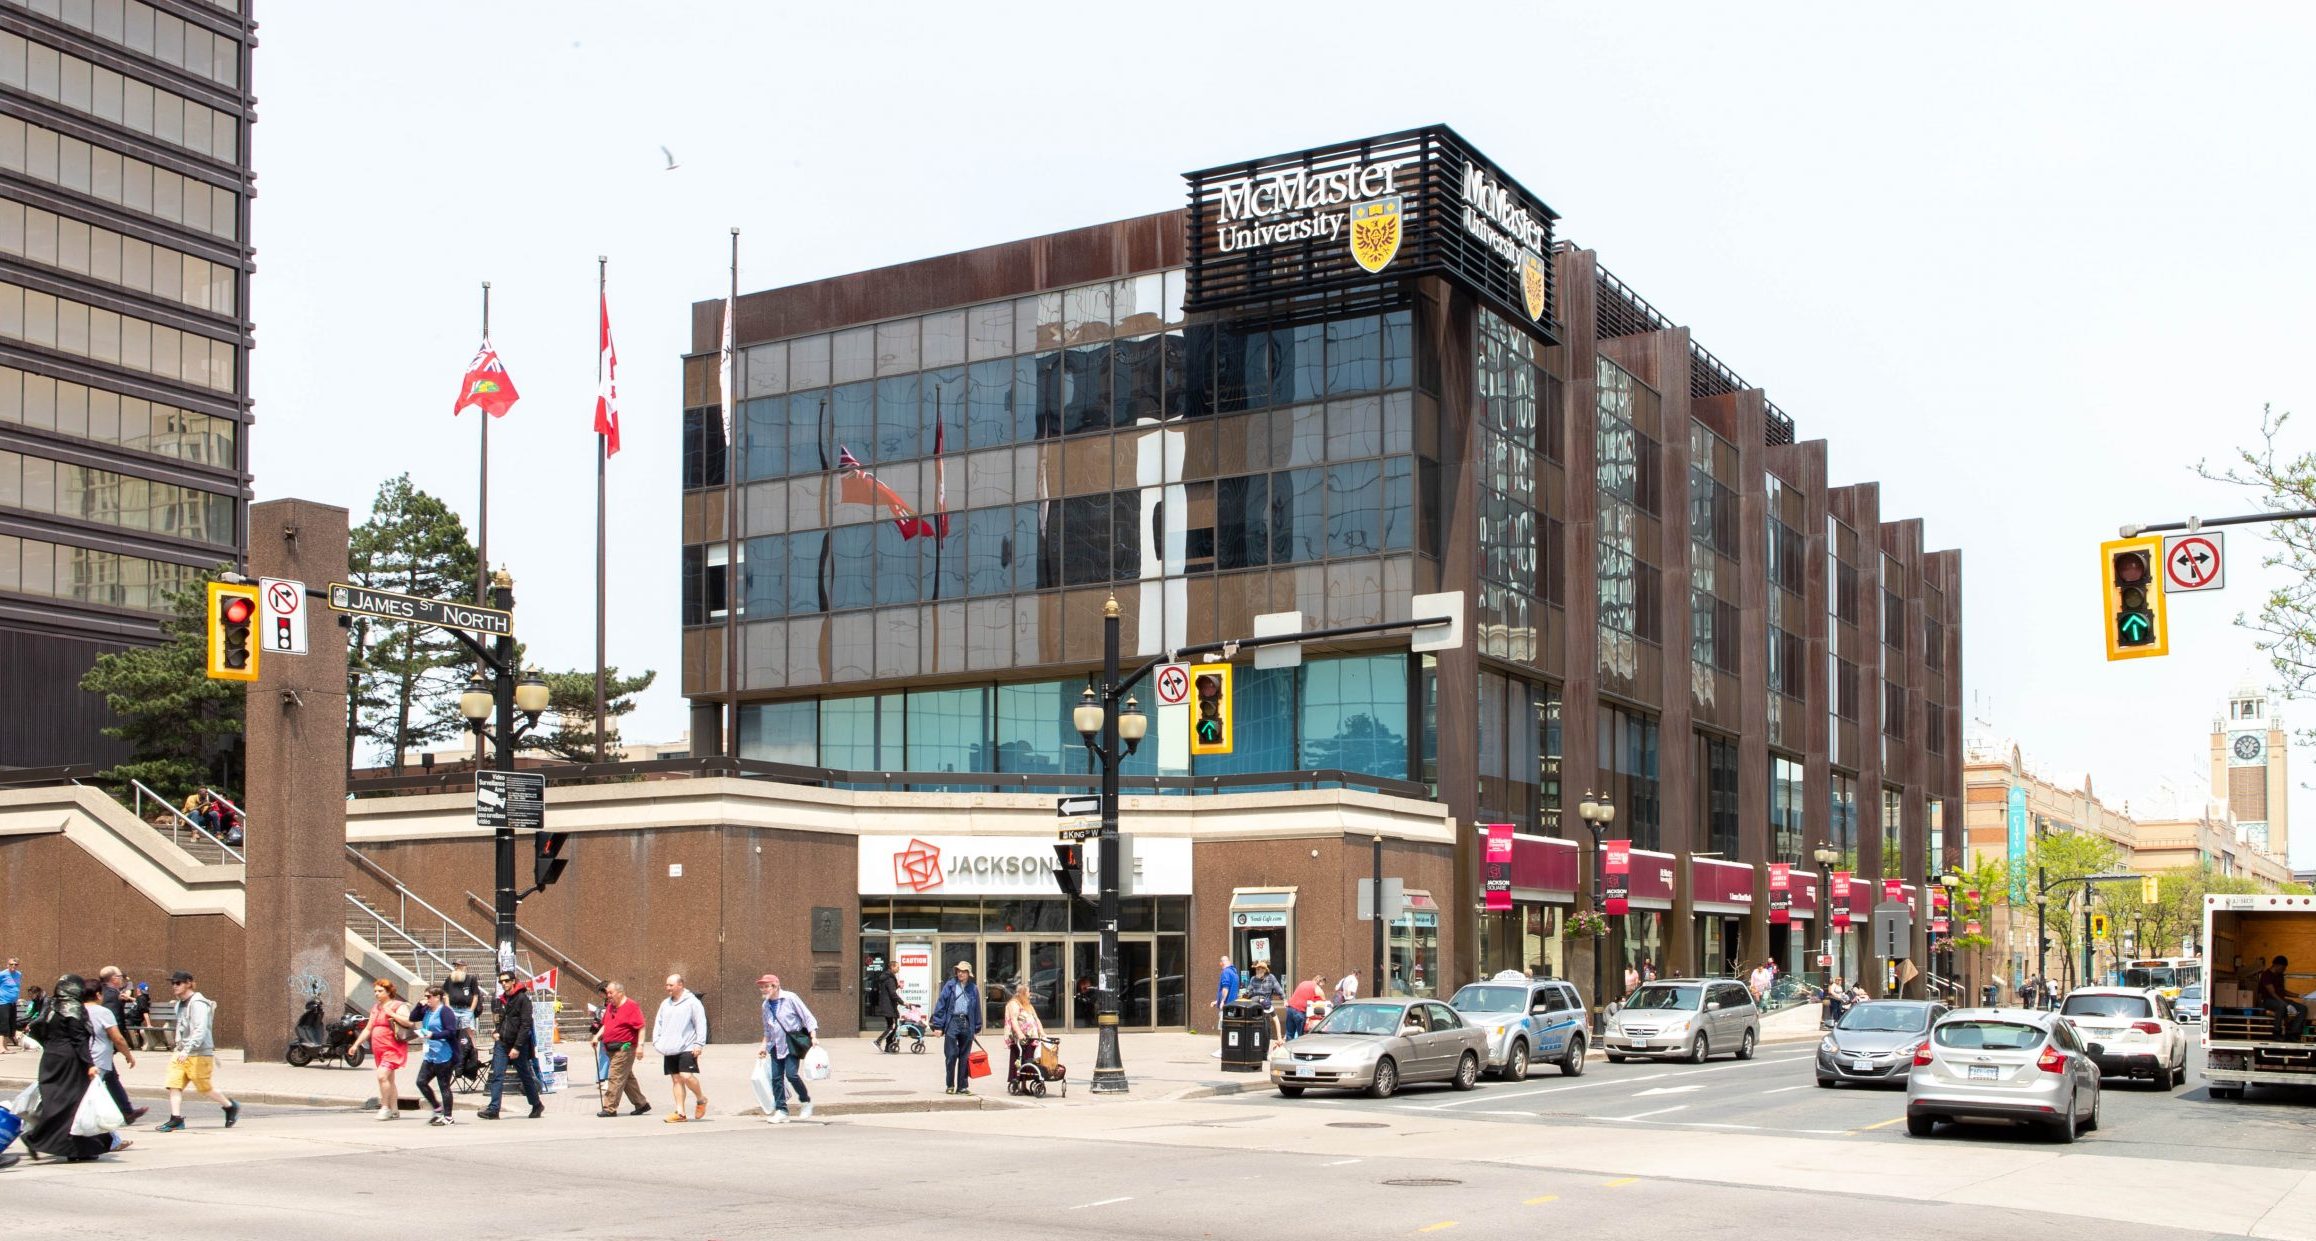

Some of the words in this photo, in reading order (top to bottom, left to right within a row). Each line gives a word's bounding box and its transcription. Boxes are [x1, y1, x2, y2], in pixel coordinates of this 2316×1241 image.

[1217, 163, 1403, 224] McMaster
[1461, 160, 1544, 255] McMaster
[1217, 211, 1345, 252] University
[1461, 204, 1521, 273] University
[352, 592, 414, 617] JAMES
[443, 605, 507, 632] NORTH
[1068, 830, 1085, 838] KING
